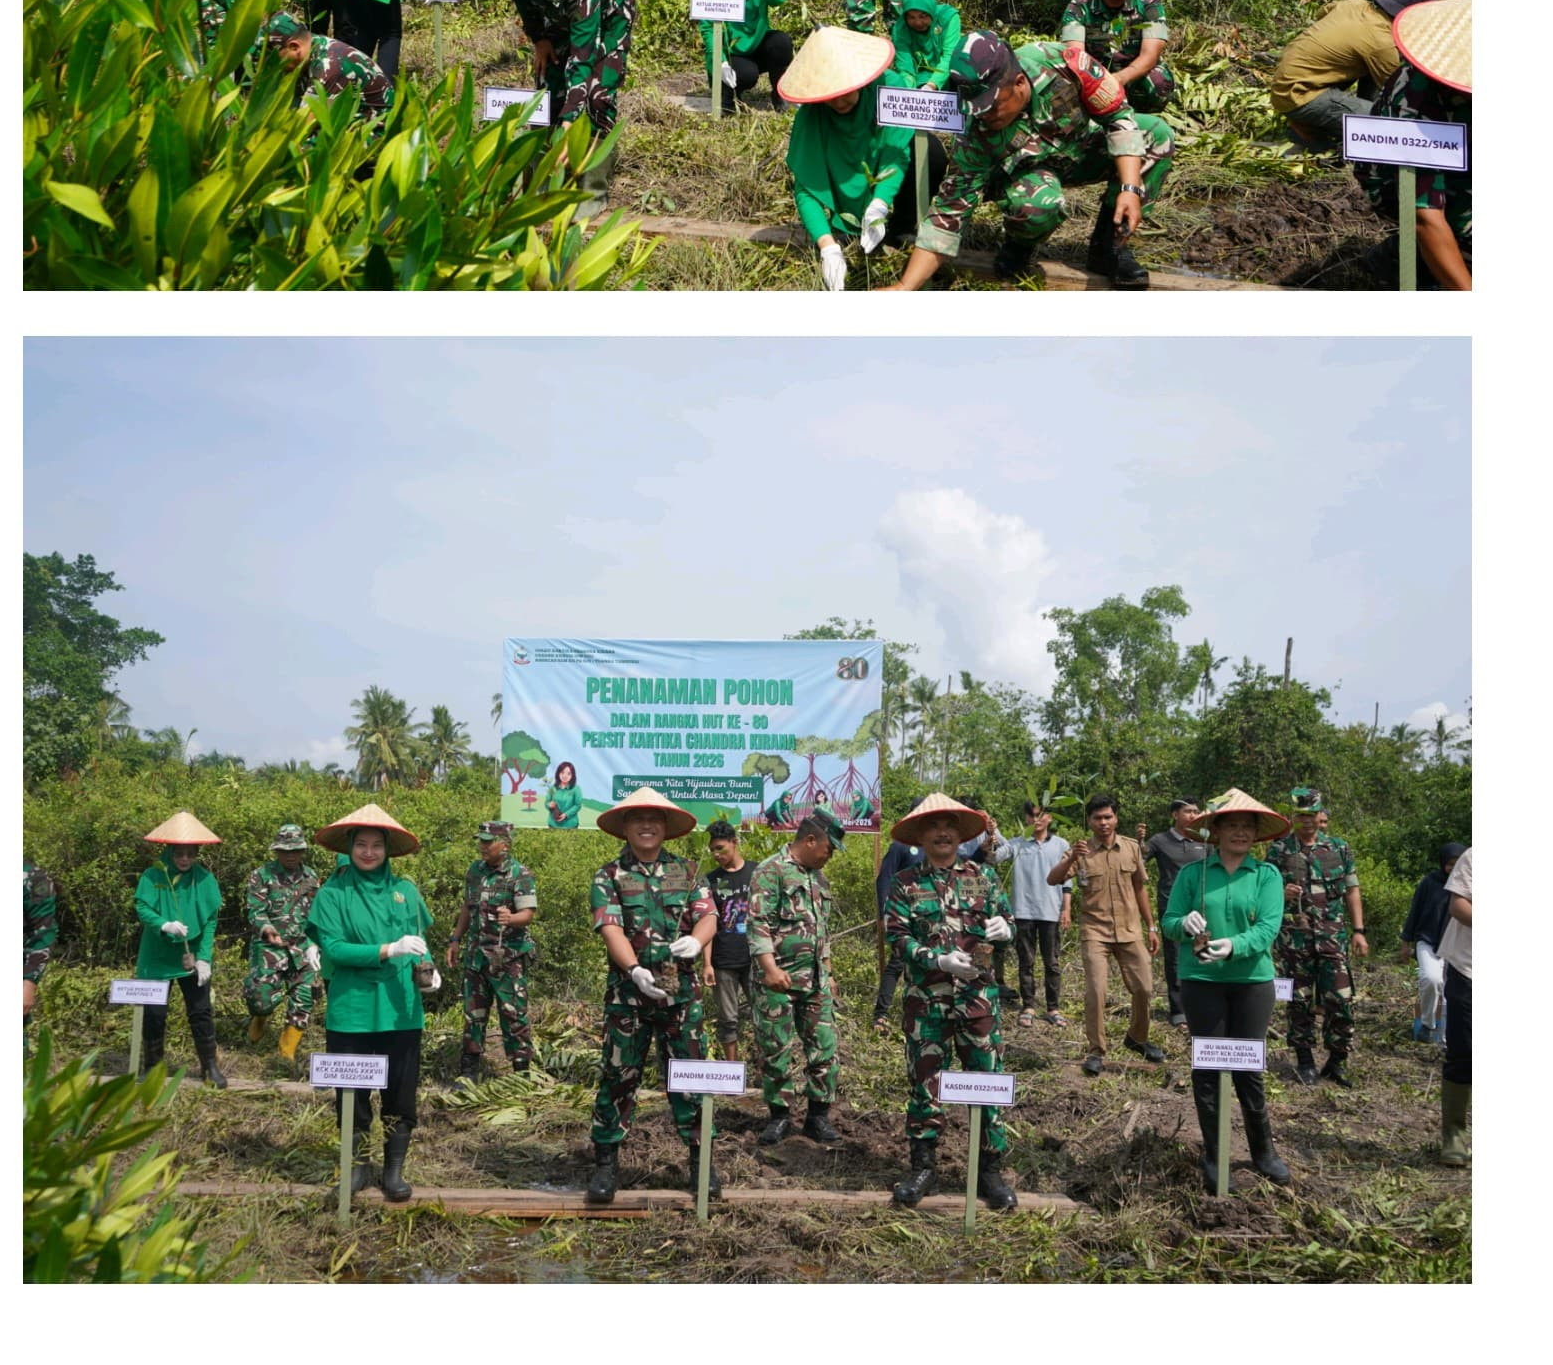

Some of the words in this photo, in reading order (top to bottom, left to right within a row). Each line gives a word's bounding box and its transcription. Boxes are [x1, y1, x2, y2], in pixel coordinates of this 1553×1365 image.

[899, 104, 931, 113] CABANG
[933, 107, 959, 116] XXXVII
[902, 96, 926, 106] KETUA
[928, 99, 954, 108] PERSIT
[892, 110, 907, 118] DIM
[911, 112, 949, 123] 0322/SIAK
[1351, 132, 1399, 145] DANDIM
[1401, 136, 1459, 151] 0322/SIAK
[835, 657, 869, 680] 80
[586, 676, 717, 704] PENANAMAN
[724, 678, 793, 706] POHON
[610, 713, 651, 729] DALAM
[654, 713, 699, 729] RANGKA
[702, 714, 724, 729] HUT
[727, 714, 741, 729] KE
[753, 714, 768, 730] 80
[582, 731, 625, 748] PERSIT
[628, 732, 682, 749] KARTIKA
[685, 733, 746, 750] CHANDRA
[749, 733, 796, 751] KIRANA
[653, 752, 691, 768] TAHUN
[693, 753, 724, 768] 2026
[945, 1083, 973, 1091] KASDIM
[974, 1084, 1009, 1092] 0322/SIAK
